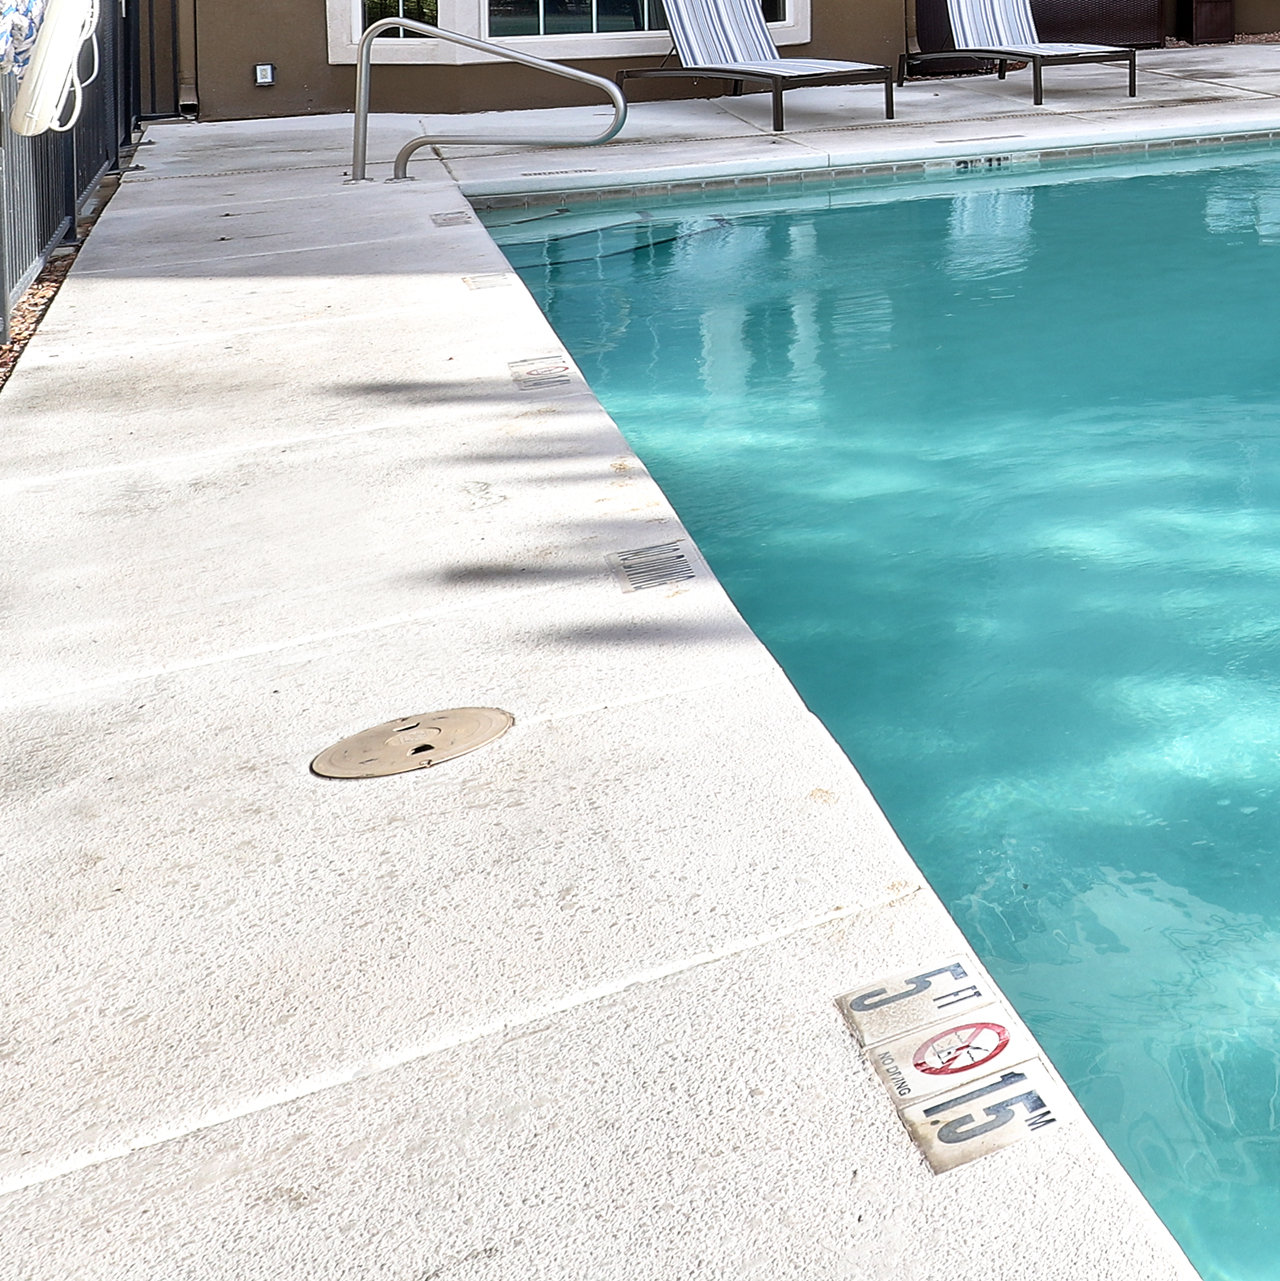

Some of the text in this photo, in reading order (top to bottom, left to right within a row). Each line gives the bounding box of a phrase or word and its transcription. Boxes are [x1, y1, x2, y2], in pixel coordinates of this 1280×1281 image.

[849, 961, 982, 1012] 5 FT
[878, 1050, 912, 1098] NO DIVING
[922, 1070, 1057, 1145] 1.5 M
